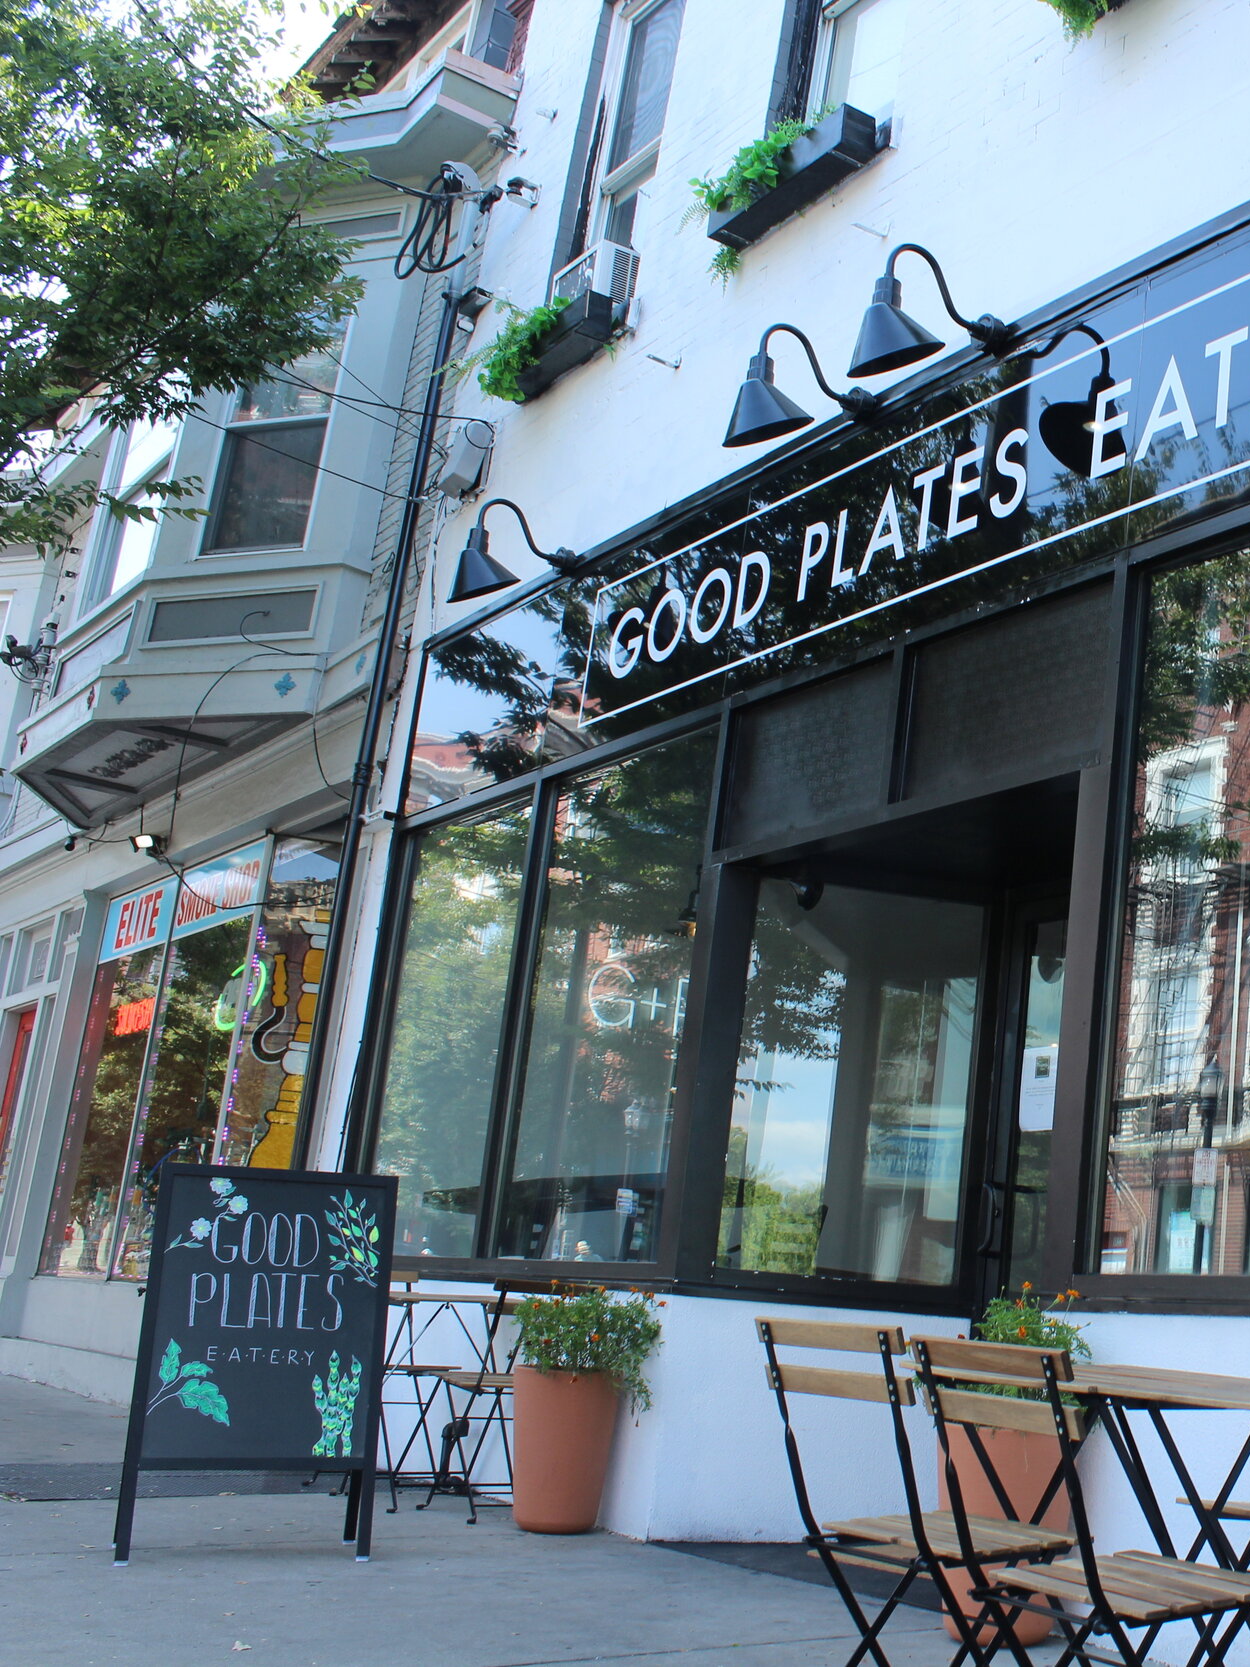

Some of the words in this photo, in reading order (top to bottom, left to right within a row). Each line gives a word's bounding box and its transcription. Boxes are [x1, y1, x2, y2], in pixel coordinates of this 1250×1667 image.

[608, 550, 771, 680] GOOD
[796, 428, 1029, 603] PLATES
[114, 889, 164, 950] ELITE
[177, 871, 223, 927] SMOKE
[222, 859, 261, 909] SHOP
[211, 1212, 320, 1267] GOOD
[188, 1272, 345, 1331] PLATES
